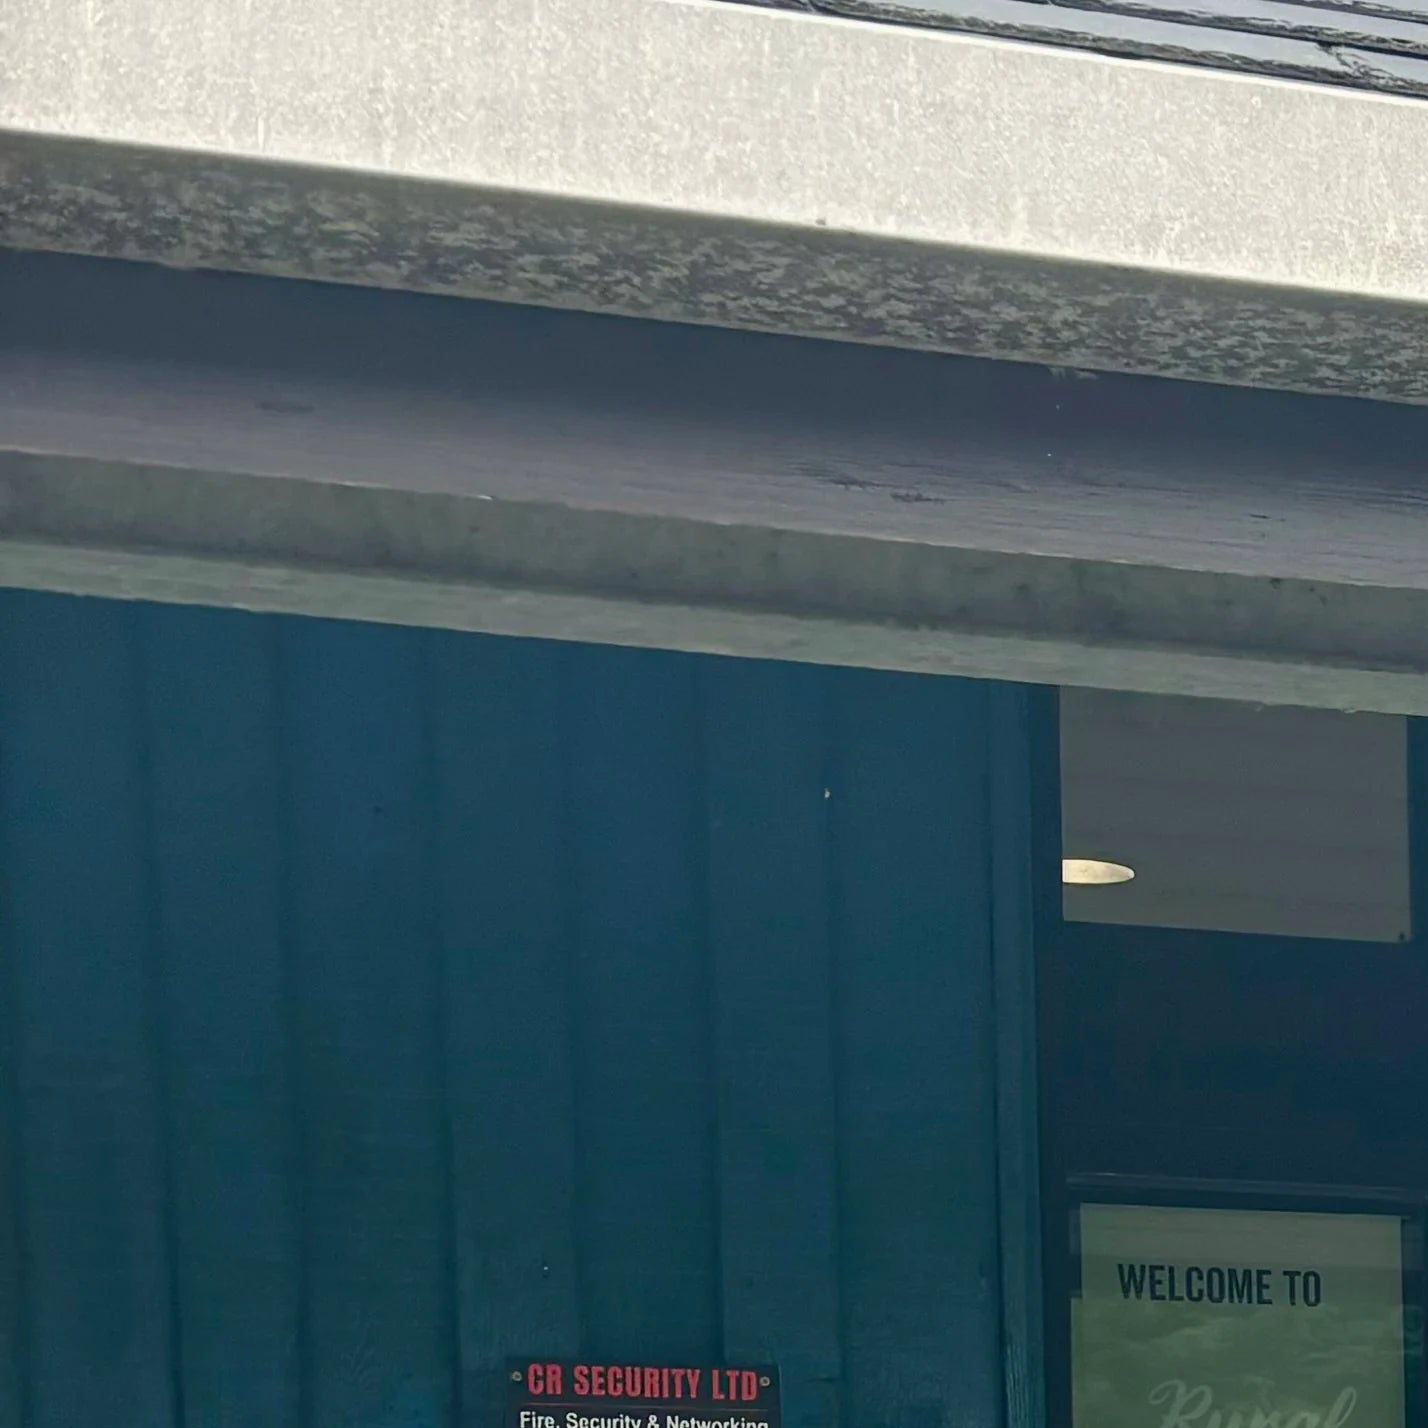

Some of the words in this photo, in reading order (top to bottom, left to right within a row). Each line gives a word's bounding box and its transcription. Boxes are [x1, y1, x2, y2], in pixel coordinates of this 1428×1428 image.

[1118, 1263, 1274, 1305] WELCOME
[1282, 1270, 1322, 1307] TO
[527, 1363, 562, 1395] CR
[574, 1365, 700, 1399] SECURITY
[712, 1369, 759, 1401] LTD
